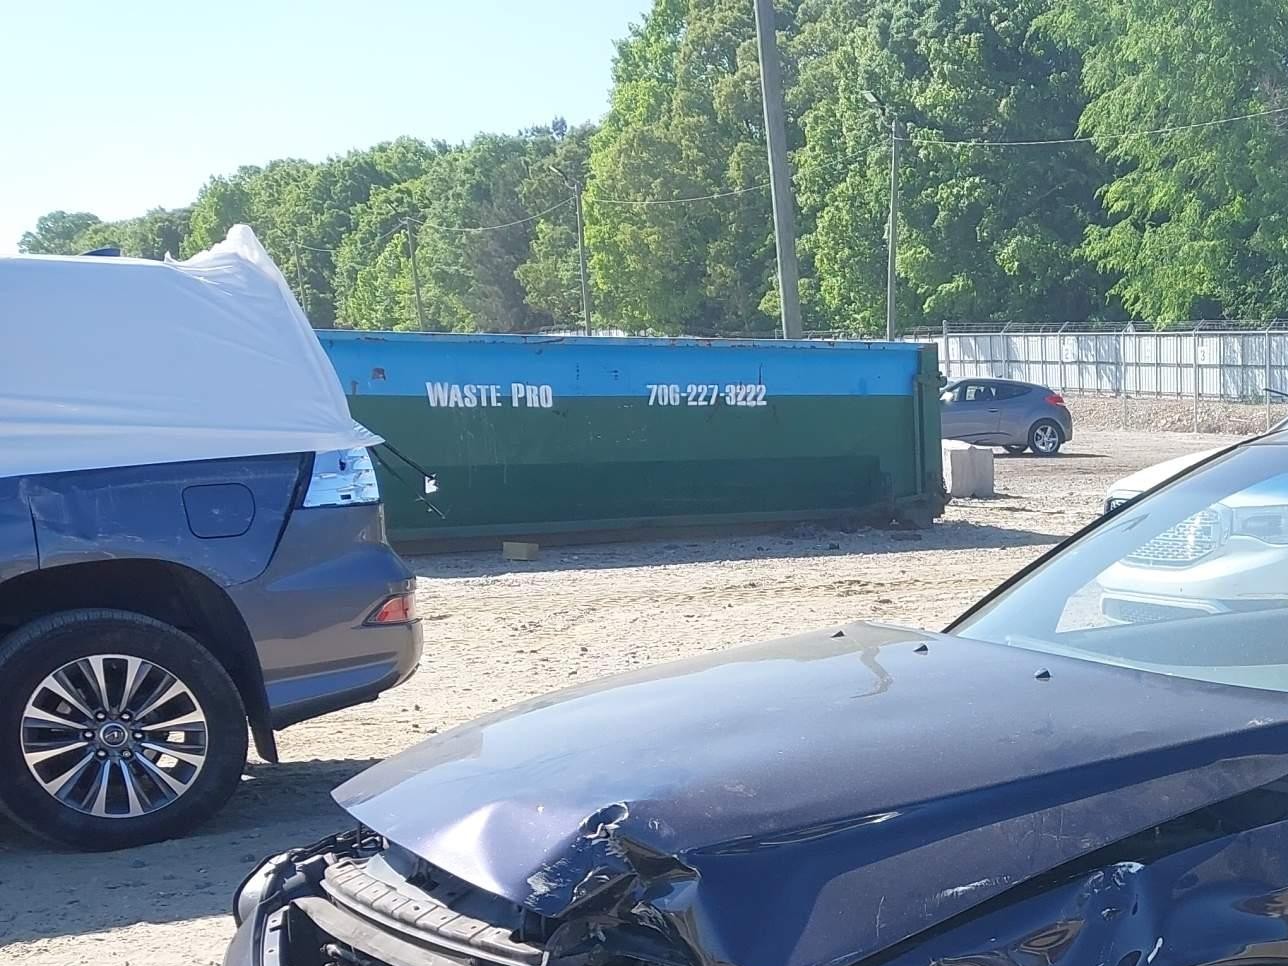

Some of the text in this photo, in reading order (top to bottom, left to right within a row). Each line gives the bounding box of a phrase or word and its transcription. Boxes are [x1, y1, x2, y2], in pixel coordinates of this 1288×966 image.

[425, 381, 552, 408] WASTE PRO
[646, 383, 767, 408] 706-227-3222
